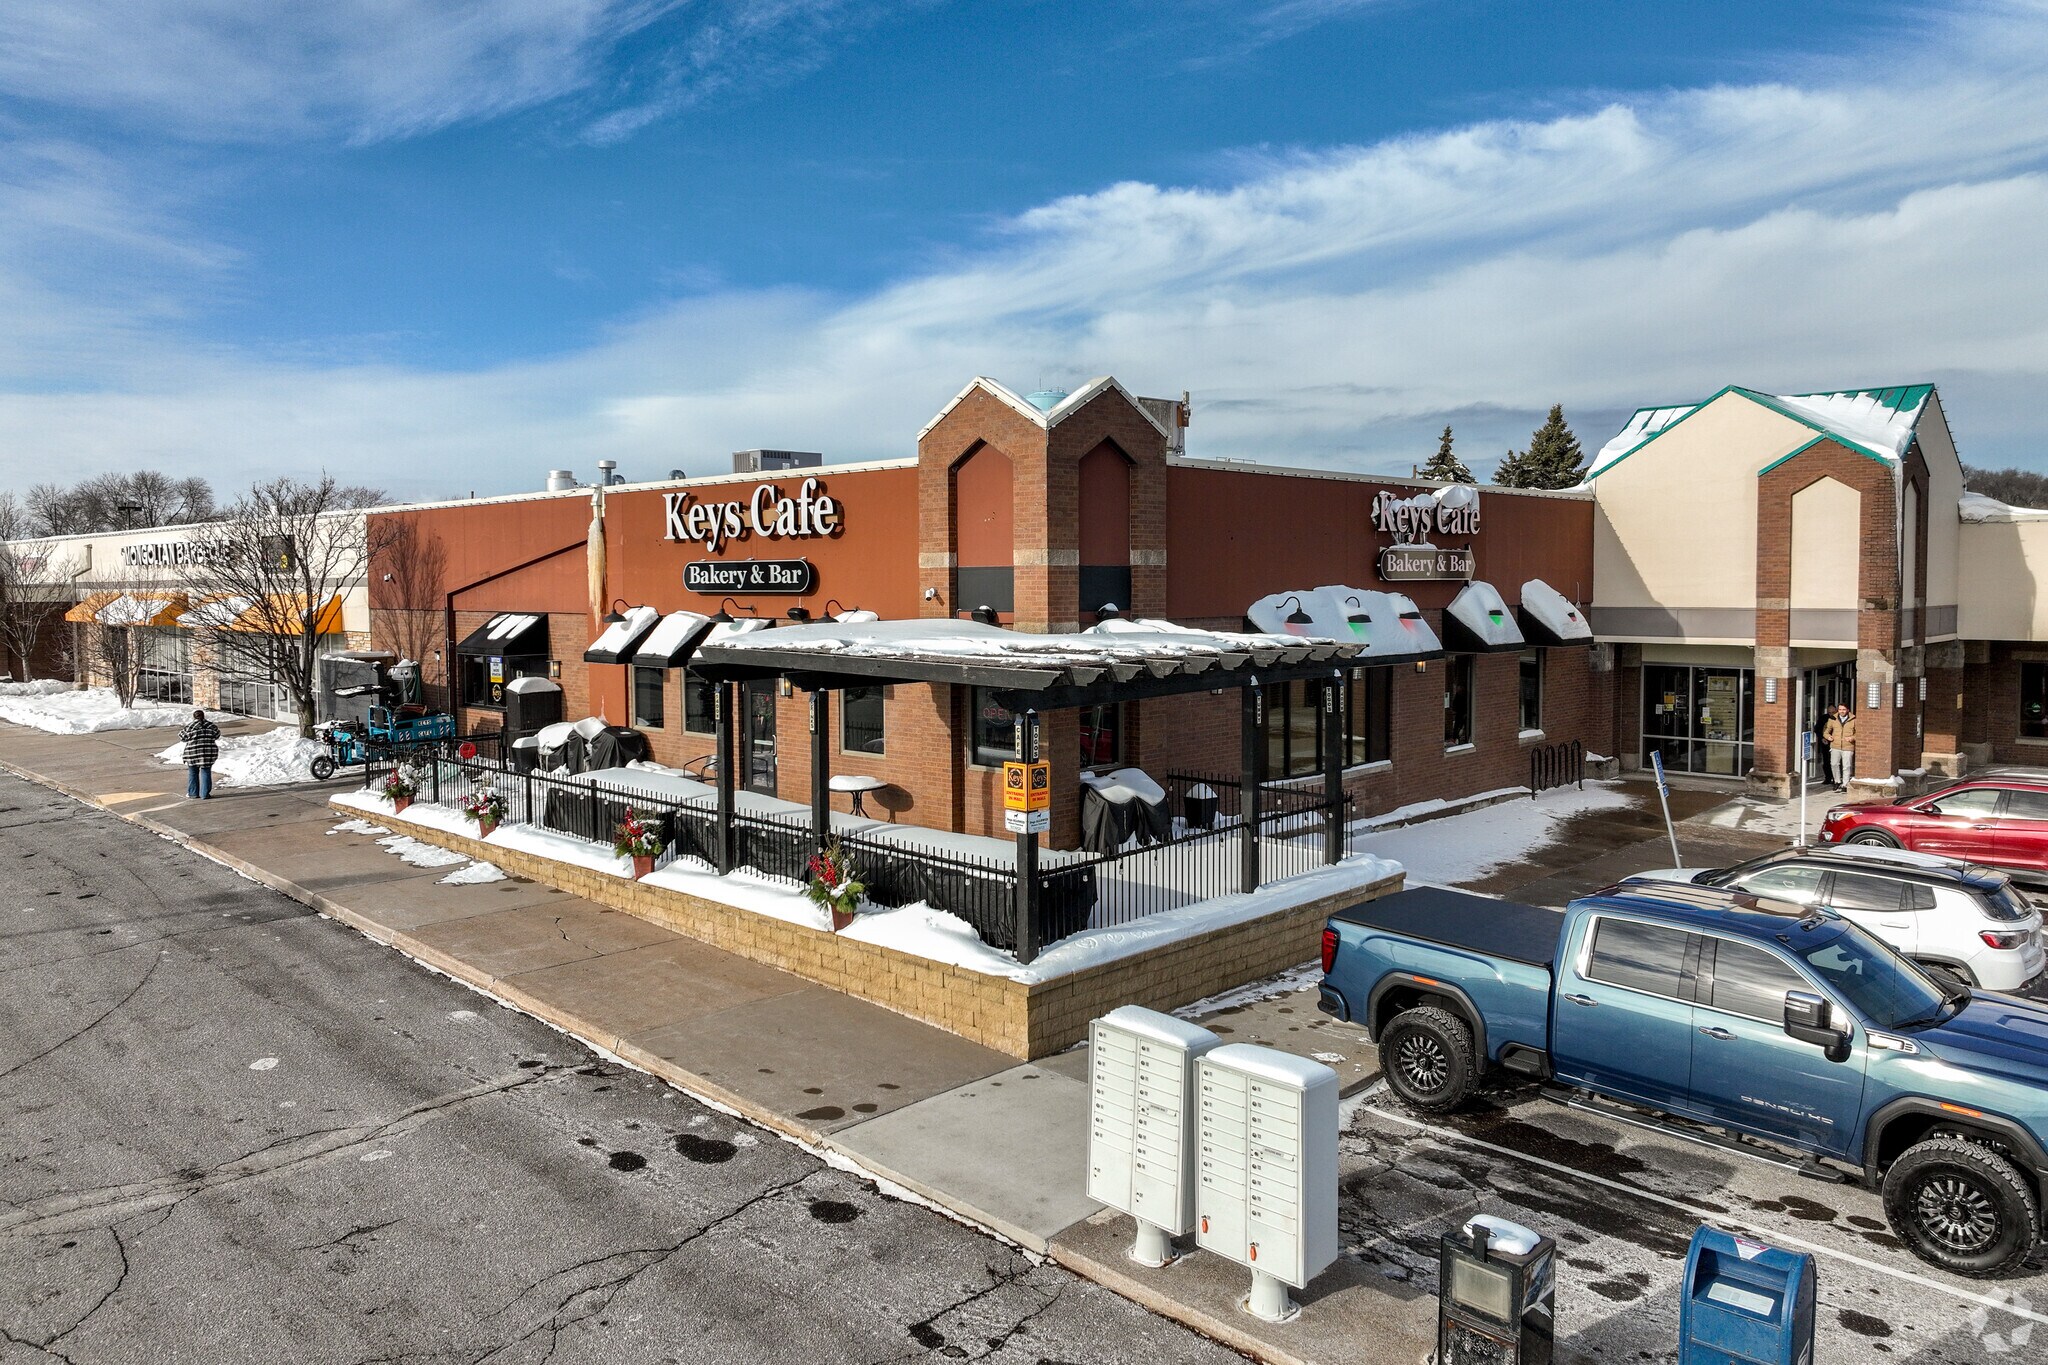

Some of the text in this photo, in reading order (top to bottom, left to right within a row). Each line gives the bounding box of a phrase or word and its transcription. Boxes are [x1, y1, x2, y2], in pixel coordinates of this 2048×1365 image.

[662, 477, 835, 552] Keys Cafe
[1378, 493, 1480, 543] Keys Cafe
[689, 564, 802, 589] Bakery & Bar
[1386, 553, 1472, 576] Bakery & Bar
[1740, 1095, 1834, 1125] DENALI HD
